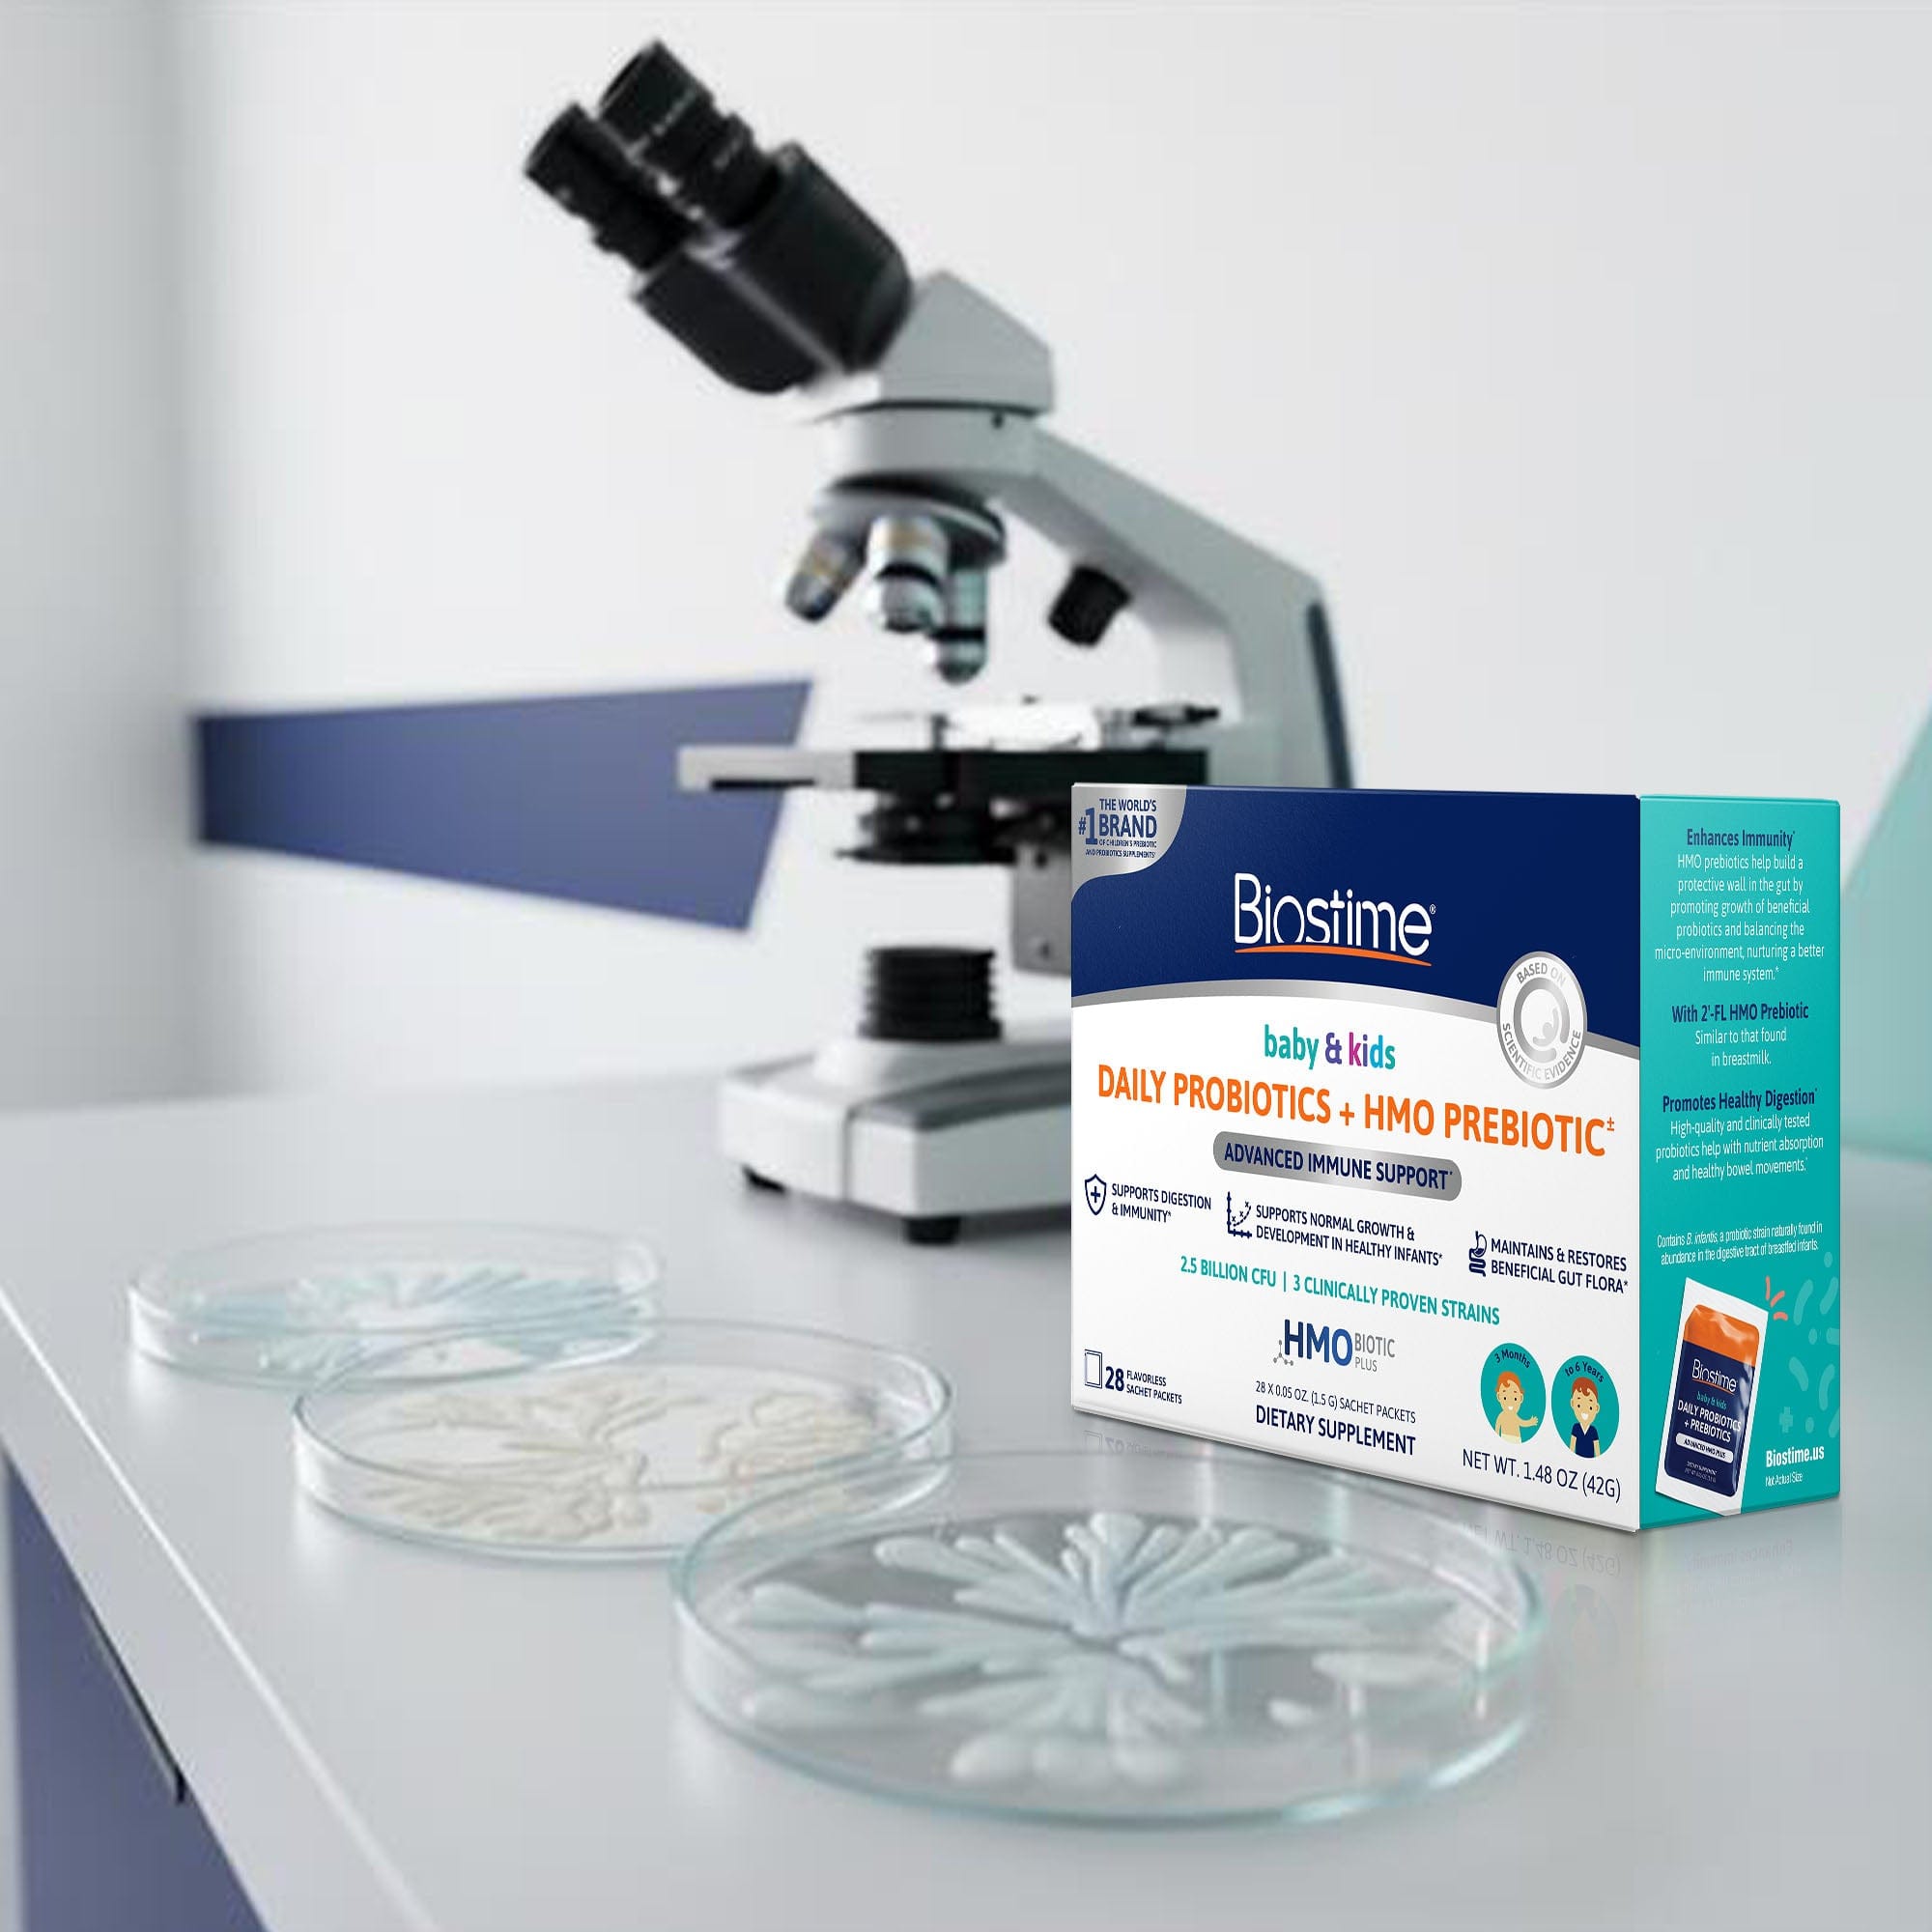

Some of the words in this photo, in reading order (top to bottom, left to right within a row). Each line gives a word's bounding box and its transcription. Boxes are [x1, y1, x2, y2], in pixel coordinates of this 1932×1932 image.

[1099, 799, 1116, 810] THE
[1078, 808, 1097, 845] #1
[1098, 813, 1157, 838] BRAND
[1687, 828, 1739, 846] Enhances
[1677, 854, 1701, 868] HMO
[1704, 854, 1749, 872] prebiotics
[1751, 854, 1771, 872] help
[1774, 854, 1796, 869] build
[1798, 858, 1804, 869] a
[1678, 877, 1724, 895] protective
[1727, 876, 1747, 892] wall
[1748, 877, 1757, 892] in
[1759, 877, 1774, 892] the
[1776, 879, 1791, 895] gut
[1793, 877, 1804, 895] by
[1670, 899, 1719, 918] promoting
[1721, 899, 1753, 918] growth
[1755, 898, 1765, 914] of
[1767, 898, 1810, 914] beneficial
[1676, 922, 1722, 940] probiotics
[1724, 922, 1742, 936] and
[1744, 921, 1788, 940] balancing
[1790, 921, 1804, 936] the
[1655, 945, 1745, 960] micro-environment,
[1747, 944, 1788, 961] nurturing
[1790, 946, 1796, 957] a
[1798, 943, 1825, 957] better
[1517, 962, 1548, 984] BASED
[1550, 967, 1566, 987] ON
[1703, 967, 1741, 981] immune
[1671, 1005, 1698, 1023] With
[1729, 1004, 1758, 1021] HMO
[1761, 1001, 1809, 1020] Prebiotic
[1264, 1024, 1320, 1070] baby
[1325, 1033, 1343, 1065] &
[1349, 1032, 1396, 1070] kids
[1695, 1029, 1727, 1045] Similar
[1729, 1030, 1739, 1043] to
[1741, 1027, 1759, 1042] that
[1761, 1027, 1787, 1042] found
[1502, 1023, 1542, 1080] SCIENTIFIC
[1545, 1030, 1581, 1081] EVIDENCE
[1711, 1052, 1720, 1066] in
[1722, 1049, 1772, 1066] breastmilk.
[1098, 1065, 1166, 1103] DAILY
[1174, 1072, 1331, 1123] PROBIOTICS
[1340, 1102, 1355, 1126] +
[1364, 1094, 1435, 1136] HMO
[1662, 1094, 1717, 1113] Promotes
[1719, 1090, 1762, 1112] Healthy
[1670, 1117, 1725, 1139] High-quality
[1726, 1117, 1743, 1132] and
[1745, 1114, 1783, 1133] clinically
[1784, 1112, 1810, 1128] tested
[1656, 1143, 1700, 1162] probiotics
[1701, 1141, 1721, 1159] help
[1723, 1140, 1742, 1154] with
[1744, 1137, 1777, 1153] nutrient
[1778, 1134, 1824, 1152] absorption
[1224, 1142, 1304, 1171] ADVANCED
[1308, 1152, 1372, 1180] IMMUNE
[1673, 1165, 1690, 1181] and
[1691, 1162, 1725, 1181] healthy
[1726, 1161, 1754, 1177] bowel
[1112, 1183, 1159, 1203] SUPPORTS
[1161, 1190, 1211, 1210] DIGESTION
[1112, 1203, 1119, 1215] &
[1256, 1205, 1308, 1225] SUPPORTS
[1310, 1212, 1354, 1233] NORMAL
[1356, 1219, 1405, 1240] GROWTH
[1407, 1227, 1415, 1241] &
[1657, 1233, 1686, 1248] Contains
[1725, 1227, 1752, 1244] probiotic
[1752, 1226, 1771, 1239] strain
[1771, 1223, 1797, 1238] naturally
[1798, 1221, 1816, 1236] found
[1816, 1220, 1823, 1234] in
[1256, 1225, 1329, 1249] DEVELOPMENT
[1331, 1236, 1343, 1251] IN
[1346, 1238, 1392, 1260] HEALTHY
[1492, 1237, 1553, 1261] MAINTAINS
[1556, 1247, 1565, 1263] &
[1568, 1249, 1627, 1272] RESTORES
[1661, 1251, 1696, 1265] abundance
[1697, 1248, 1704, 1262] in
[1705, 1248, 1716, 1261] the
[1716, 1245, 1745, 1263] digestive
[1745, 1244, 1759, 1257] tract
[1760, 1242, 1767, 1256] of
[1492, 1260, 1555, 1284] BENEFICIAL
[1558, 1270, 1582, 1288] GUT
[1180, 1256, 1198, 1274] 2.5
[1201, 1259, 1248, 1283] BILLION
[1252, 1267, 1276, 1287] CFU
[1293, 1274, 1301, 1292] 3
[1304, 1276, 1378, 1305] CLINICALLY
[1381, 1289, 1437, 1316] PROVEN
[1441, 1298, 1500, 1326] STRAINS
[1284, 1319, 1353, 1367] HMO
[1354, 1332, 1396, 1358] BIOTIC
[1354, 1356, 1378, 1372] PLUS
[1494, 1352, 1501, 1364] 3
[1501, 1349, 1531, 1369] Months
[1564, 1366, 1575, 1377] to
[1575, 1361, 1580, 1373] 6
[1582, 1360, 1605, 1383] Years
[1105, 1365, 1124, 1392] 28
[1126, 1370, 1167, 1387] FLAVORLESS
[1126, 1383, 1152, 1398] SACHET
[1153, 1389, 1182, 1405] PACKETS
[1256, 1380, 1266, 1393] 28
[1267, 1382, 1274, 1396] X
[1275, 1384, 1293, 1399] 0.05
[1311, 1390, 1326, 1406] (1.5
[1327, 1395, 1338, 1411] G)
[1339, 1397, 1374, 1415] SACHET
[1376, 1404, 1416, 1424] PACKETS
[1677, 1400, 1699, 1416] DAILY
[1699, 1408, 1742, 1432] PROBIOTICS
[1256, 1405, 1315, 1435] DIETARY
[1318, 1417, 1416, 1456] SUPPLEMENT
[1690, 1418, 1732, 1443] PREBIOTICS
[1766, 1445, 1825, 1468] Biostime.us
[1463, 1448, 1491, 1471] NET
[1493, 1455, 1520, 1478] WT.
[1523, 1462, 1552, 1485] 1.48
[1556, 1468, 1578, 1491] OZ
[1582, 1471, 1621, 1504] (42G)
[1765, 1476, 1776, 1487] Not
[1775, 1473, 1792, 1486] Actual
